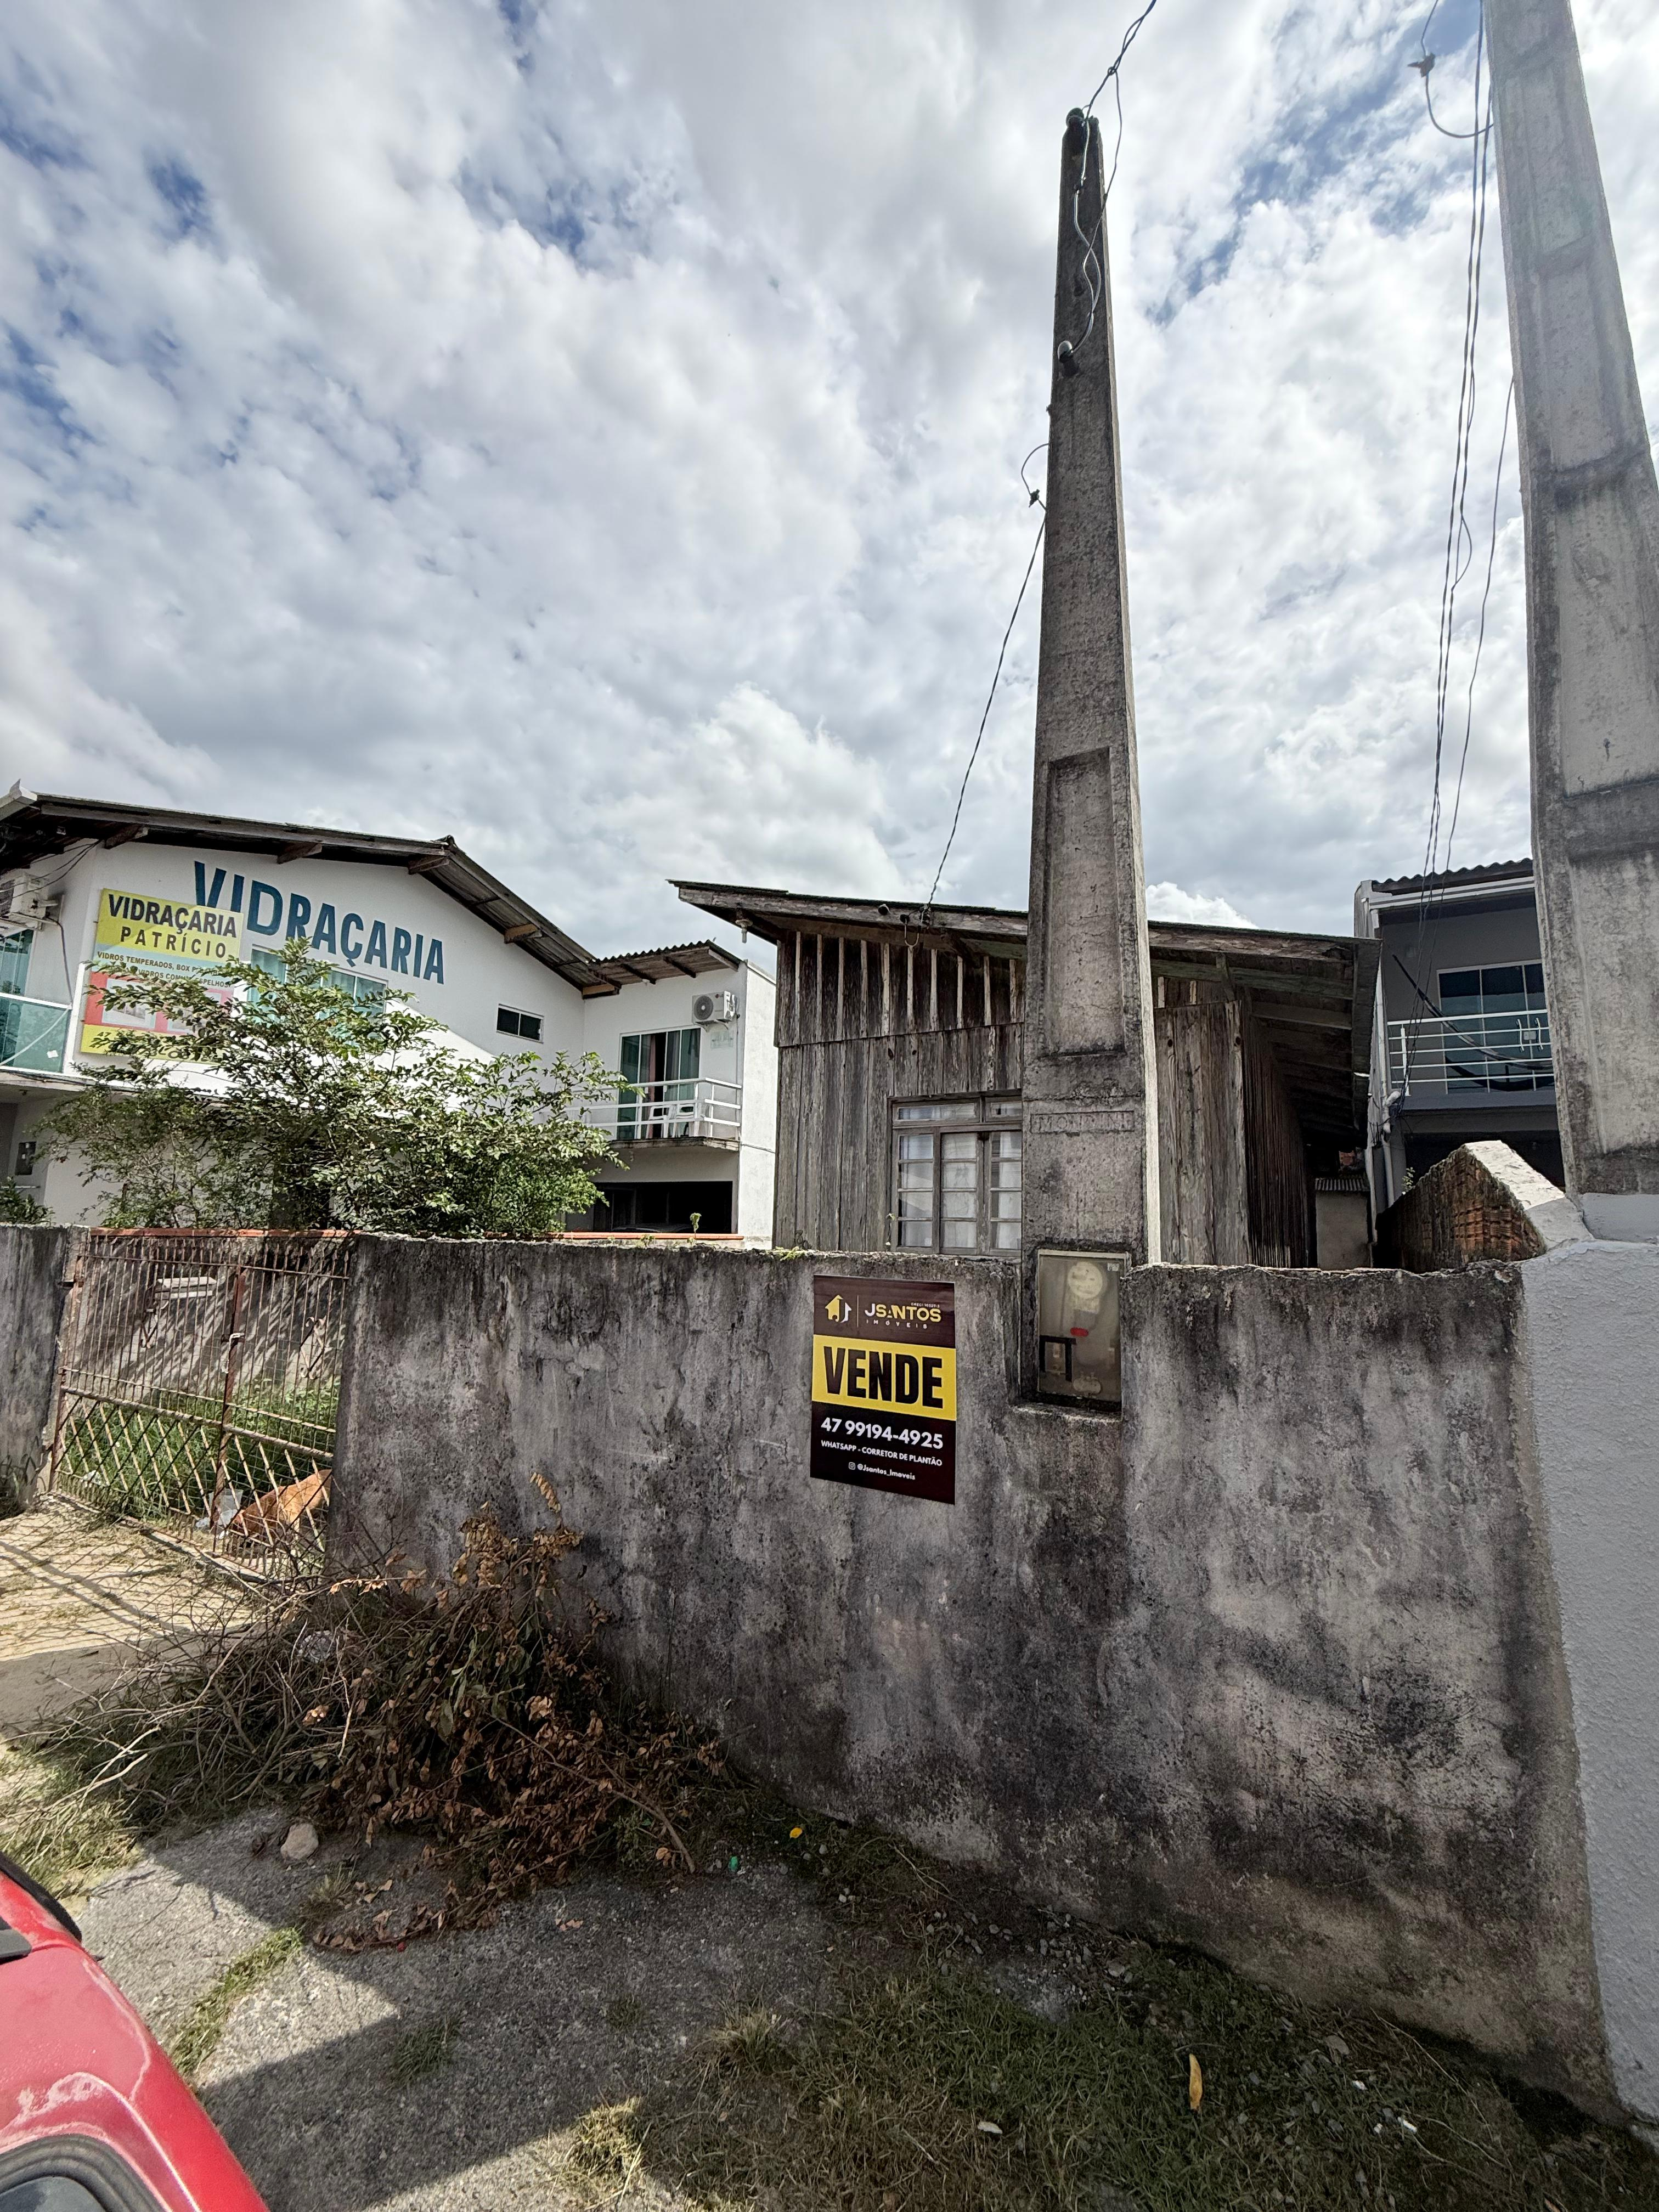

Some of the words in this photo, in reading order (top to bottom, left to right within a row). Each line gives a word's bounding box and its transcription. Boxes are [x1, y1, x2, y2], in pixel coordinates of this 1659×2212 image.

[109, 894, 236, 938] VIDRAÇARIA
[194, 861, 444, 985] VIDRAÇARIA
[120, 926, 226, 958] PATRÍCIO
[97, 951, 124, 962] VIDROS
[126, 956, 174, 970] TEMPERADOS,
[823, 1346, 944, 1409] VENDE
[821, 1417, 842, 1432] 47
[845, 1420, 944, 1449] 99194-4925
[821, 1440, 856, 1452] WHATSAPP
[861, 1447, 898, 1459] CORRETOR
[909, 1454, 943, 1466] PLANTÃO
